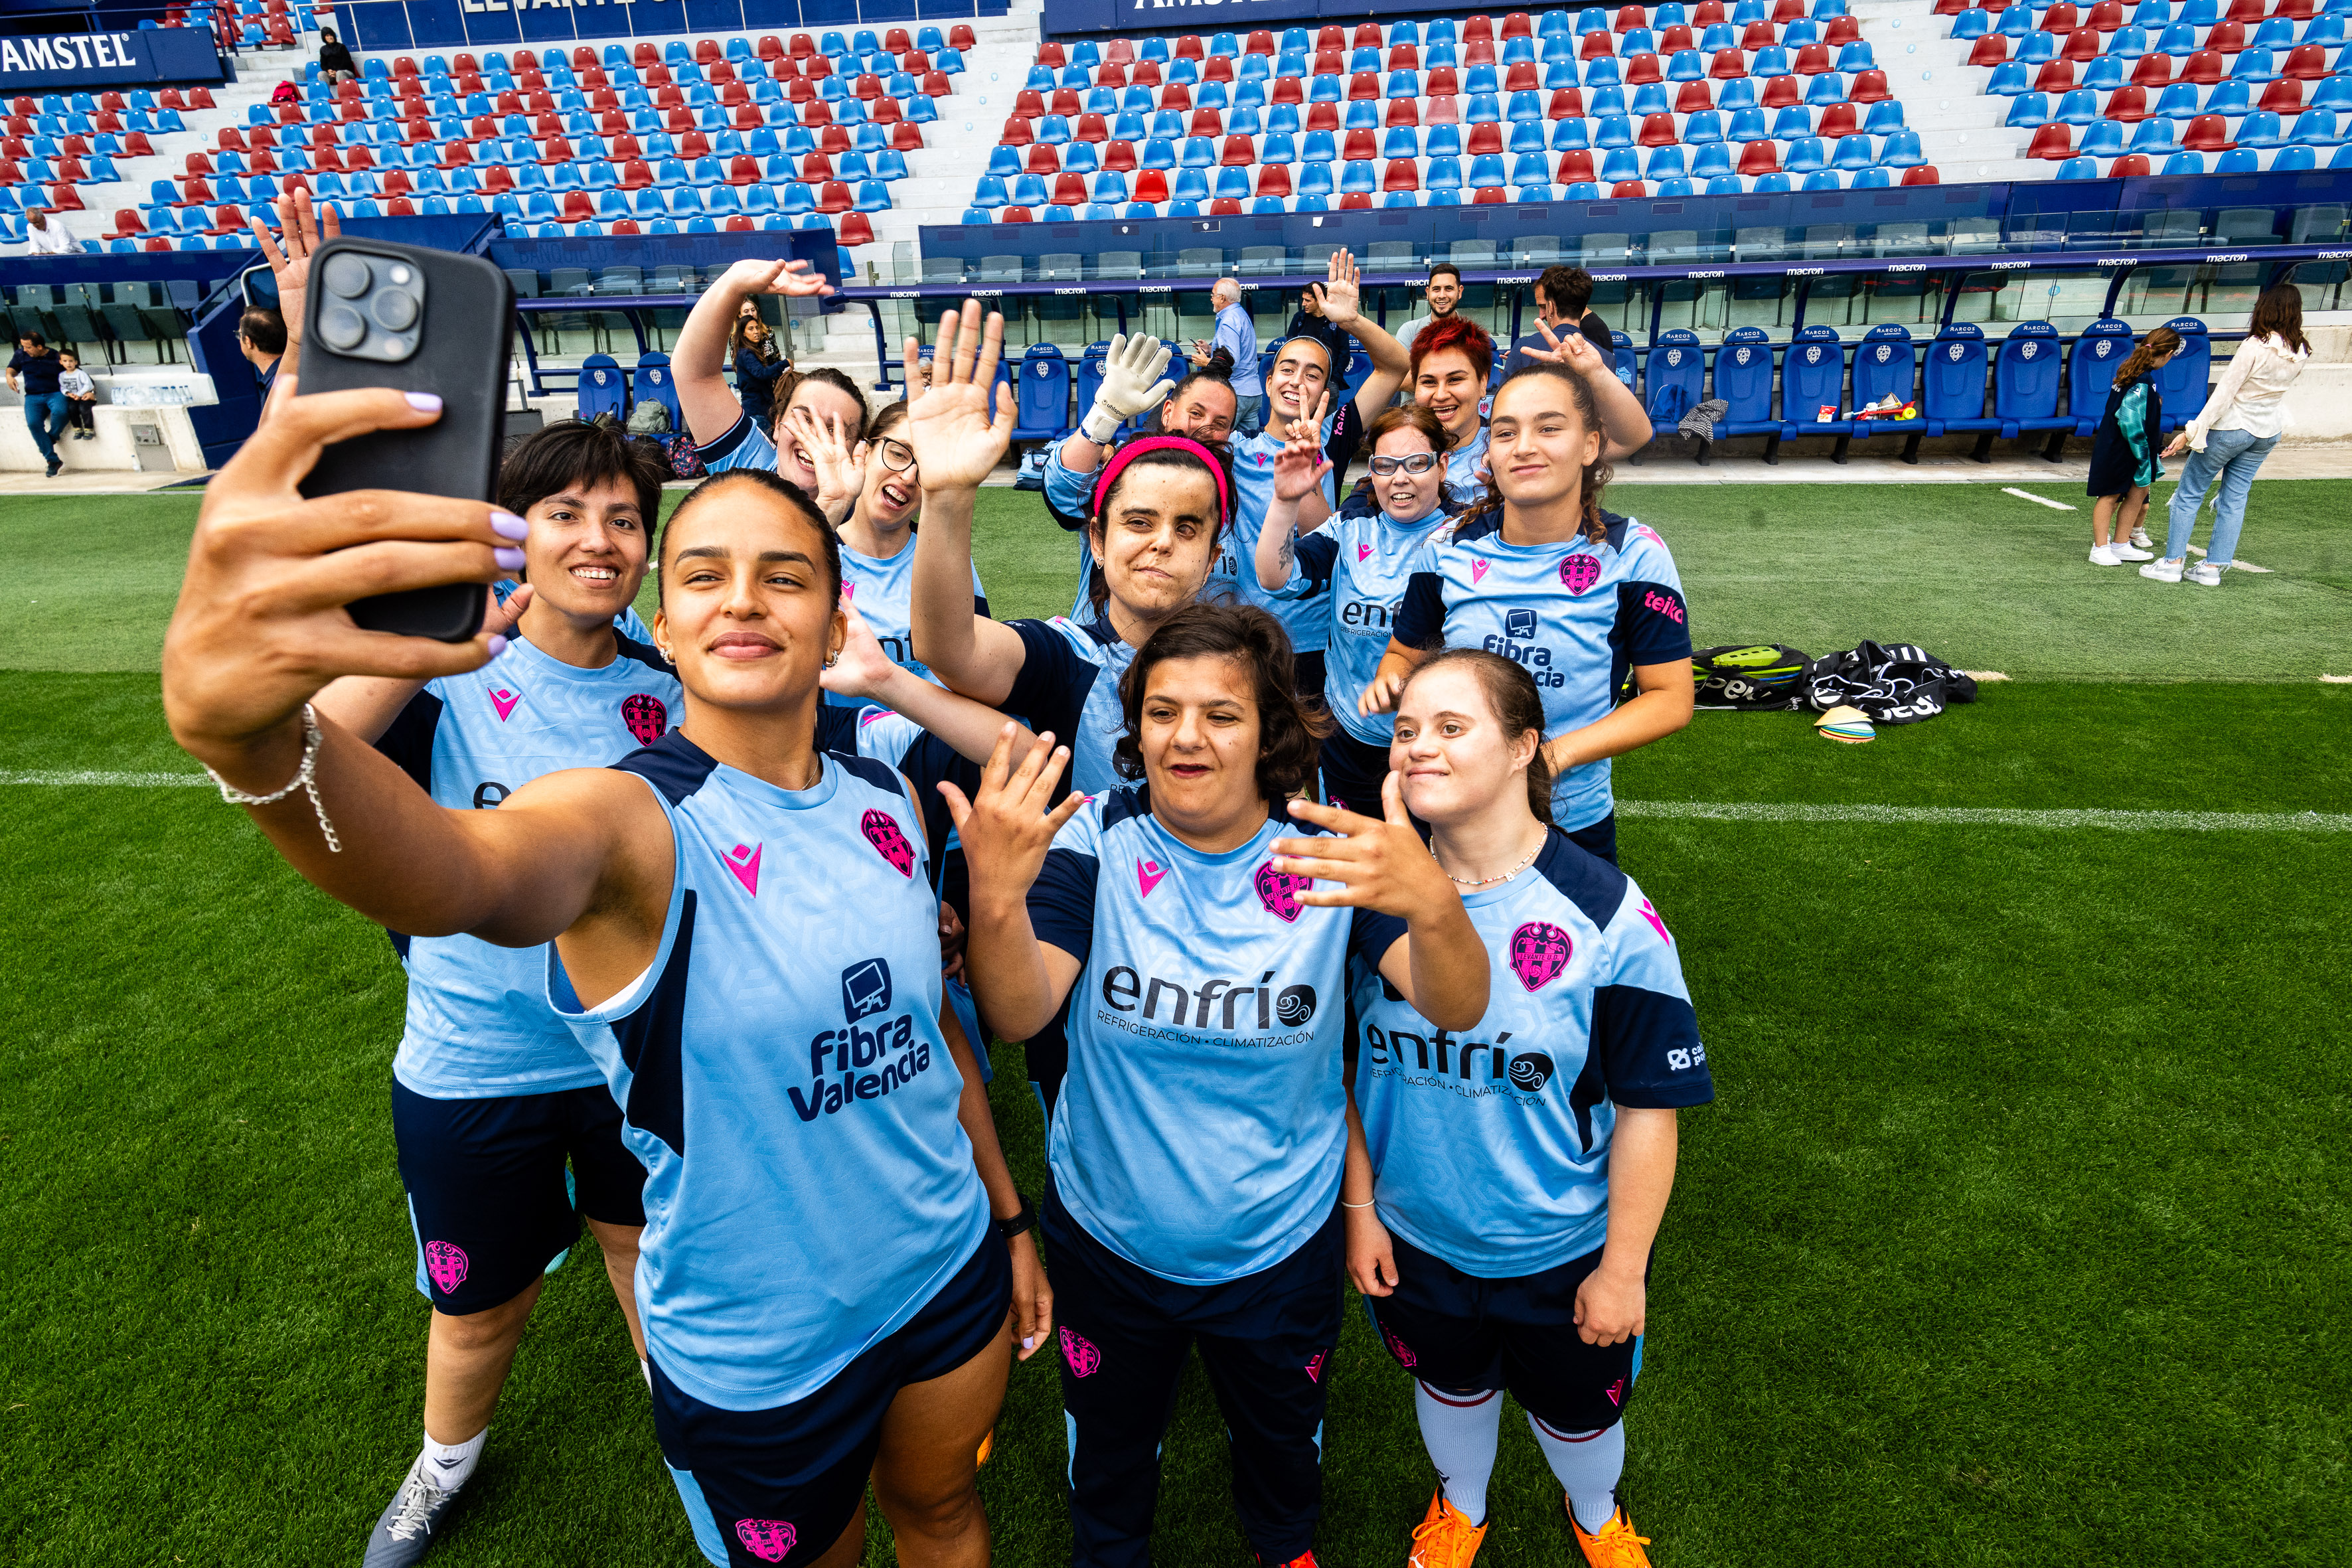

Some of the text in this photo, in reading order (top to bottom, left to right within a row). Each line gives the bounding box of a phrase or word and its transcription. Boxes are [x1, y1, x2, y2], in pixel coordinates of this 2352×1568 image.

[1992, 261, 2030, 270] macron
[1107, 404, 1127, 418] uhlsport
[1342, 601, 1403, 628] enf
[1644, 591, 1684, 624] teika
[1269, 886, 1291, 899] LEVANTE
[1097, 1010, 1314, 1048] REFRIGERACIÓN CLIMATIZACIÓN
[787, 1039, 930, 1122] Valencia
